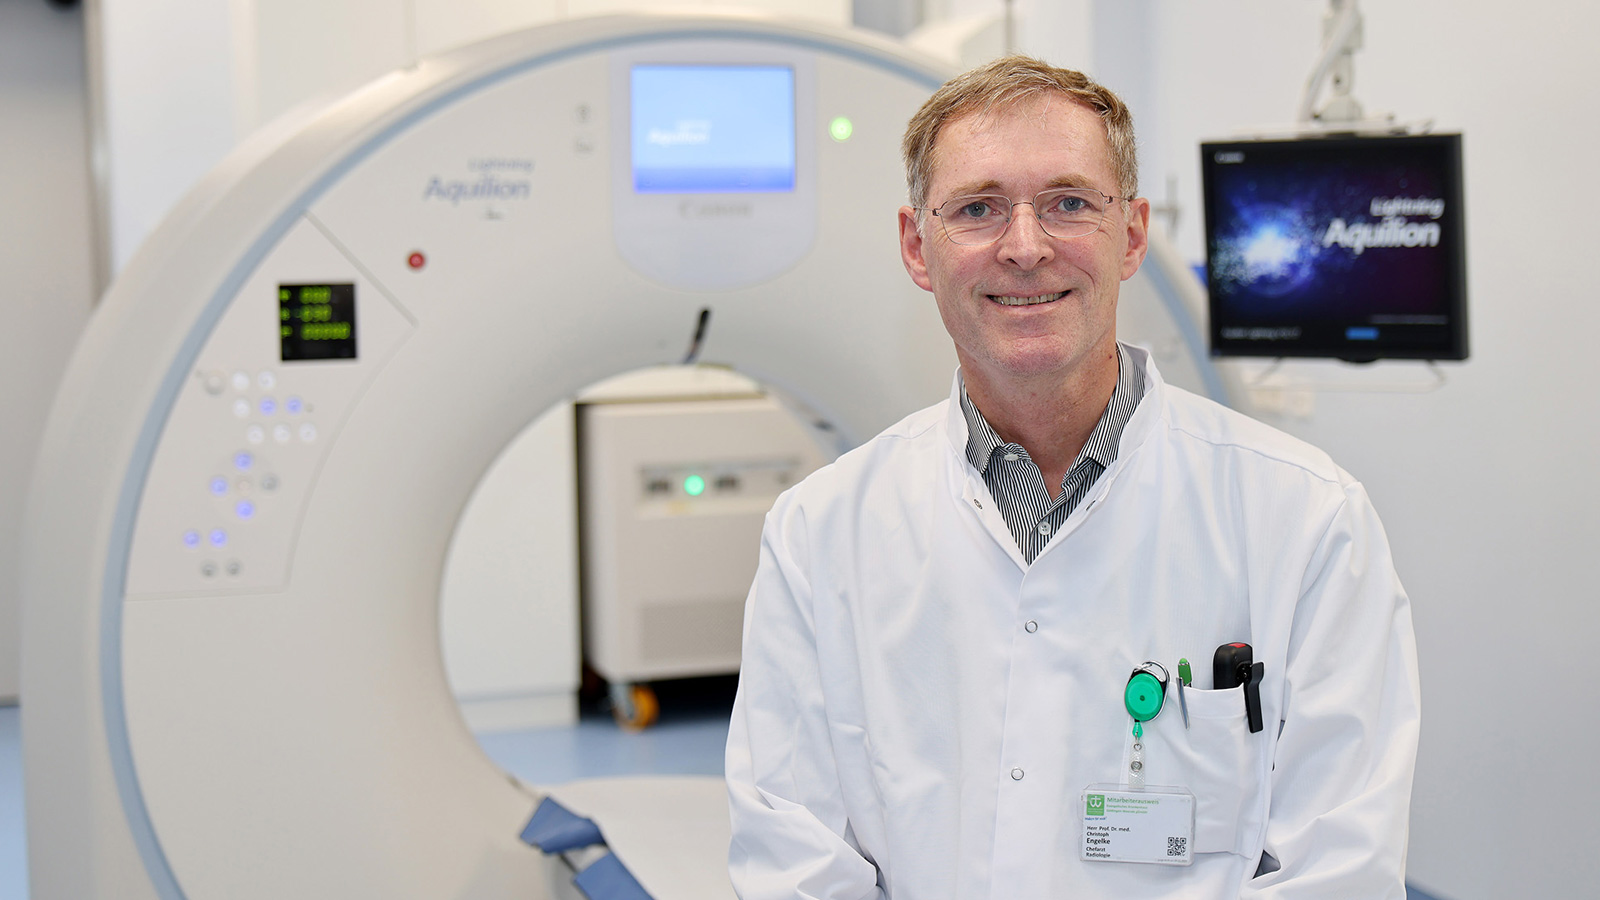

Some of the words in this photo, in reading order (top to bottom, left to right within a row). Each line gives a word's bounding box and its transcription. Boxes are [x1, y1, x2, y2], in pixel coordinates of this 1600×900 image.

[423, 174, 531, 206] Aquilion
[1370, 197, 1445, 219] Lightning
[1323, 217, 1440, 254] Aquilion
